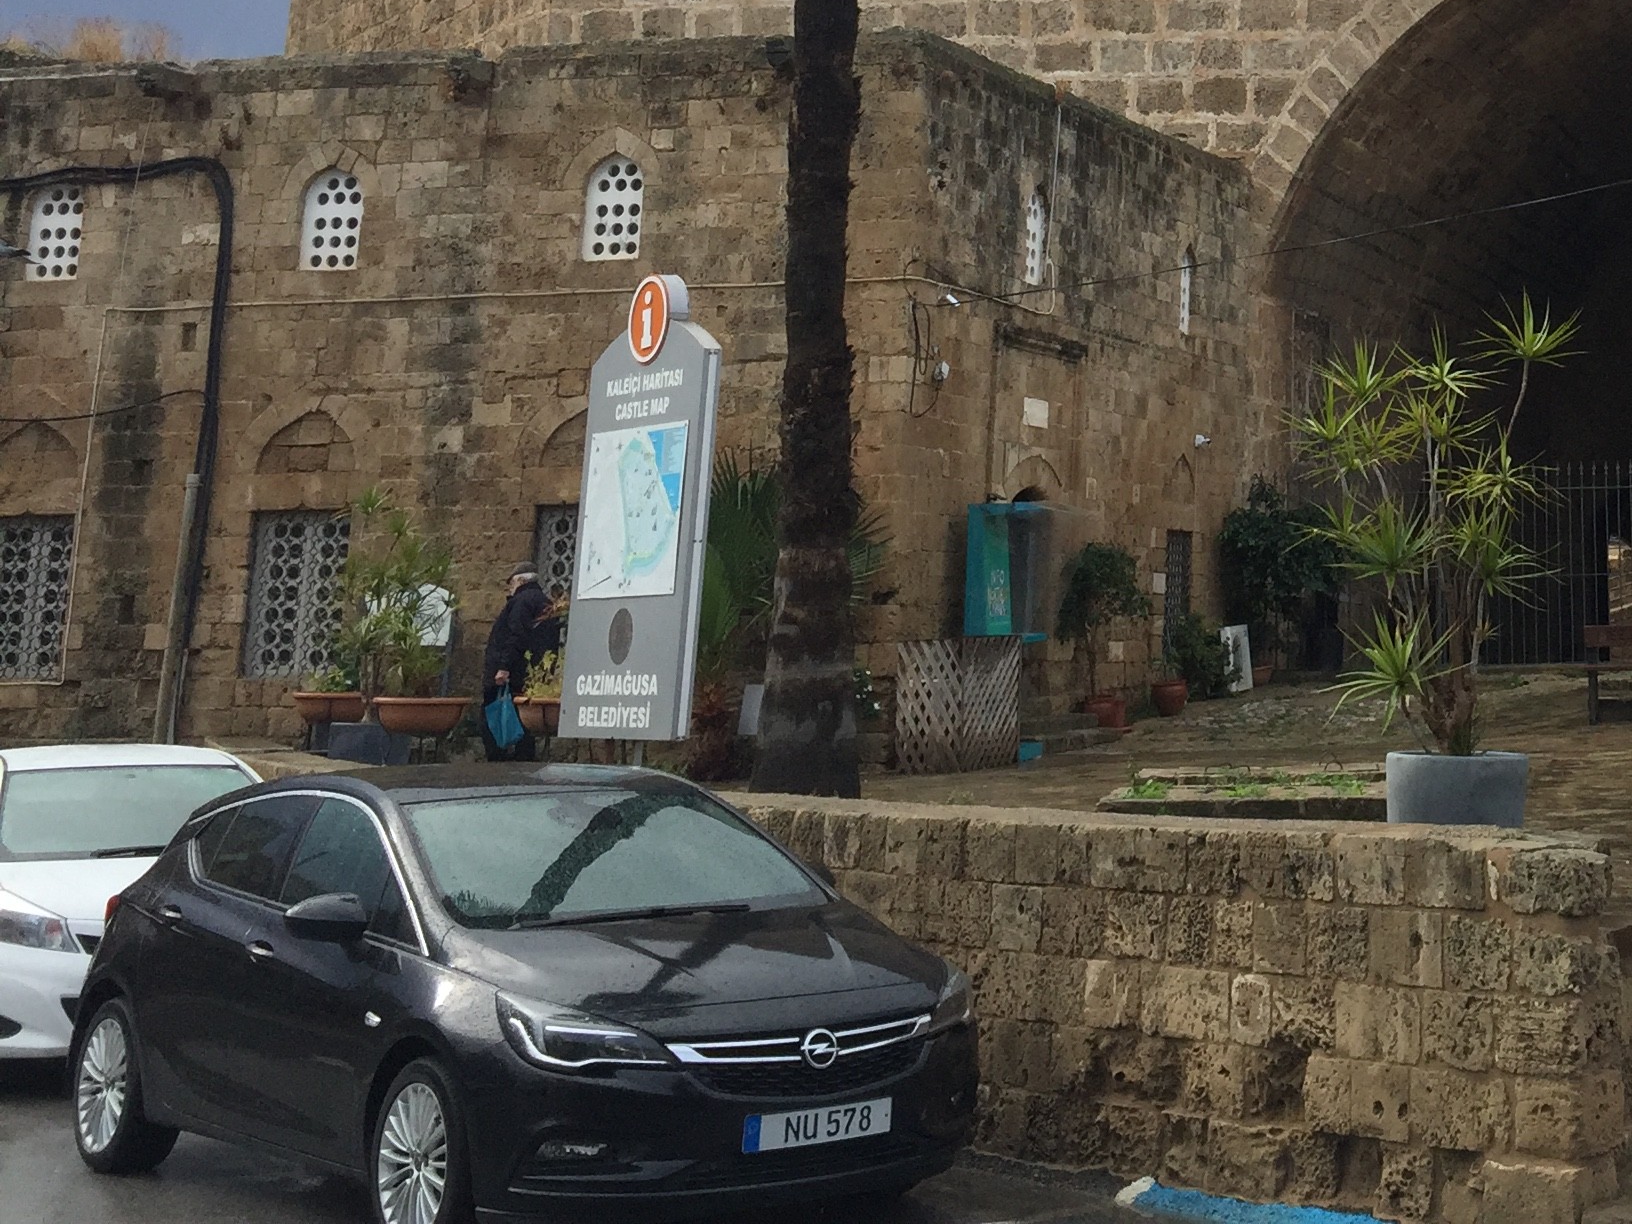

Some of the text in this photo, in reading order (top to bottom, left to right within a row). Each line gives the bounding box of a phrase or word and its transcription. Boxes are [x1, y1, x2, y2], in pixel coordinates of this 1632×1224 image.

[606, 368, 683, 397] KALEİÇİ HARİTASI
[615, 397, 670, 421] CASTLE MAP
[576, 669, 658, 696] GAZİMAĞUSA
[578, 700, 651, 728] BELEDİYESİ
[784, 1104, 872, 1144] NU 578
